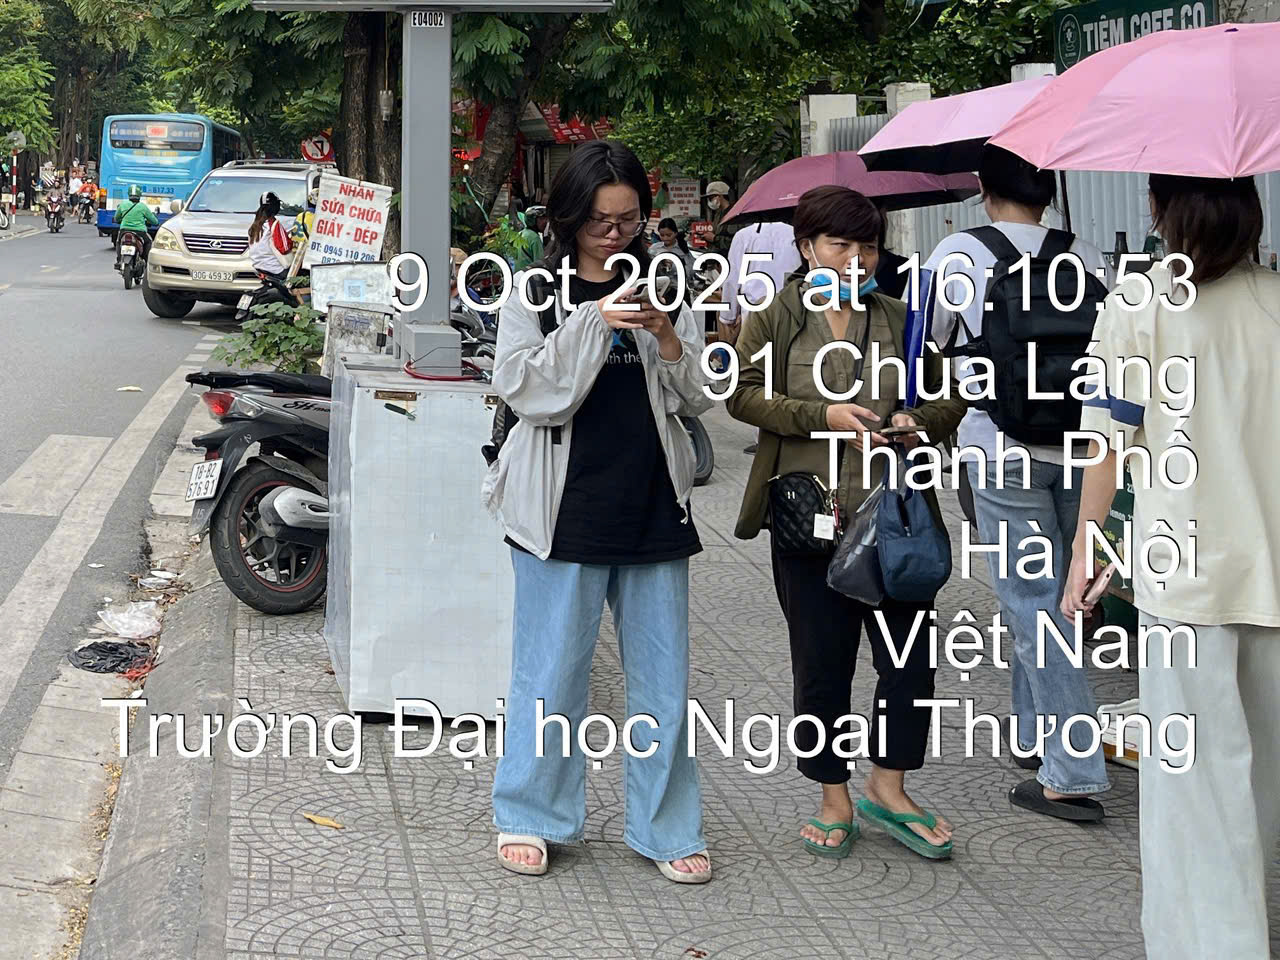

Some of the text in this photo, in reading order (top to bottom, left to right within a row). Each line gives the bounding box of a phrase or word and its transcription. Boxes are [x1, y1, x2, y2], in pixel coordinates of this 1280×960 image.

[412, 12, 444, 27] E04002
[320, 197, 382, 224] SỬA CHỮA
[323, 244, 343, 257] 0945
[345, 249, 360, 260] 110
